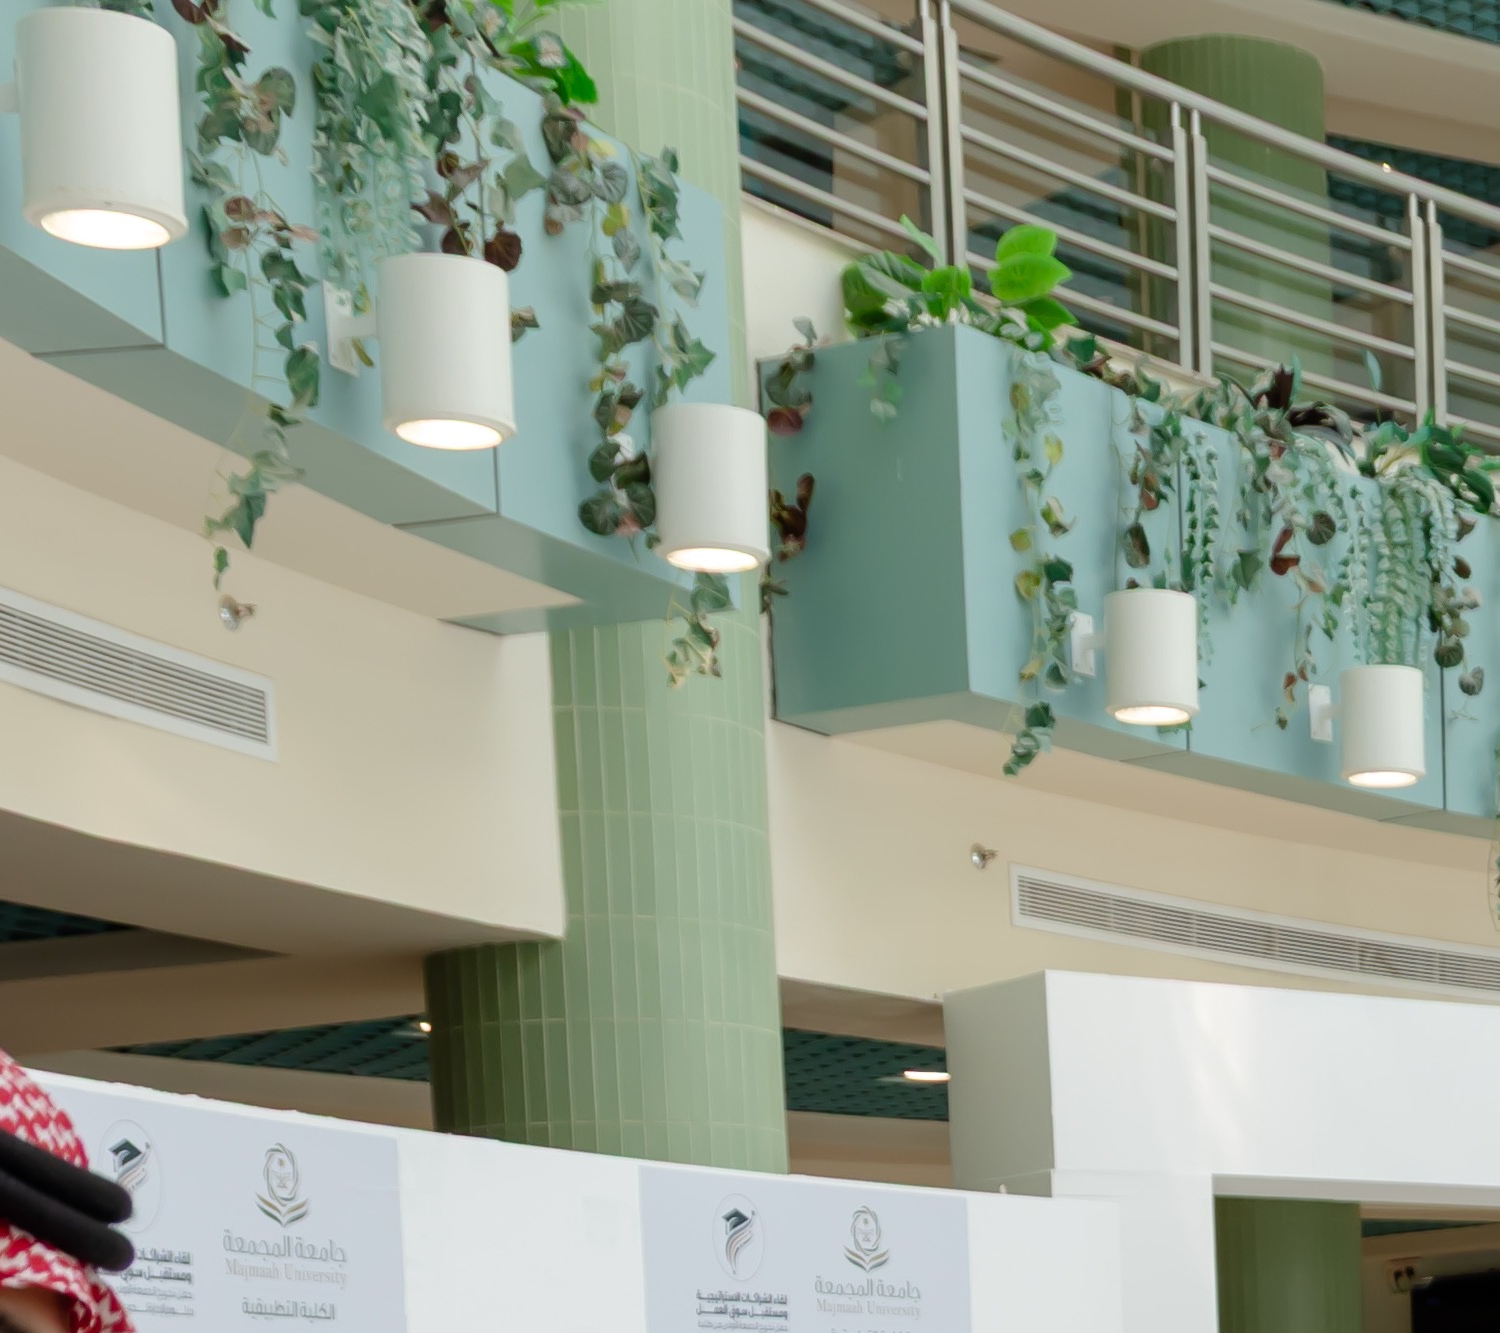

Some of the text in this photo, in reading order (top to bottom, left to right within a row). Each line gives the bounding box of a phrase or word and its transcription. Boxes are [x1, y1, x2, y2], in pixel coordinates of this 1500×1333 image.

[222, 1229, 348, 1268] جامعة المجمعة
[225, 1258, 348, 1290] Majmaah University
[814, 1275, 921, 1303] جامعة المجمعة
[241, 1297, 336, 1323] الكلية التطبيقية
[816, 1298, 921, 1320] Majmaah University
